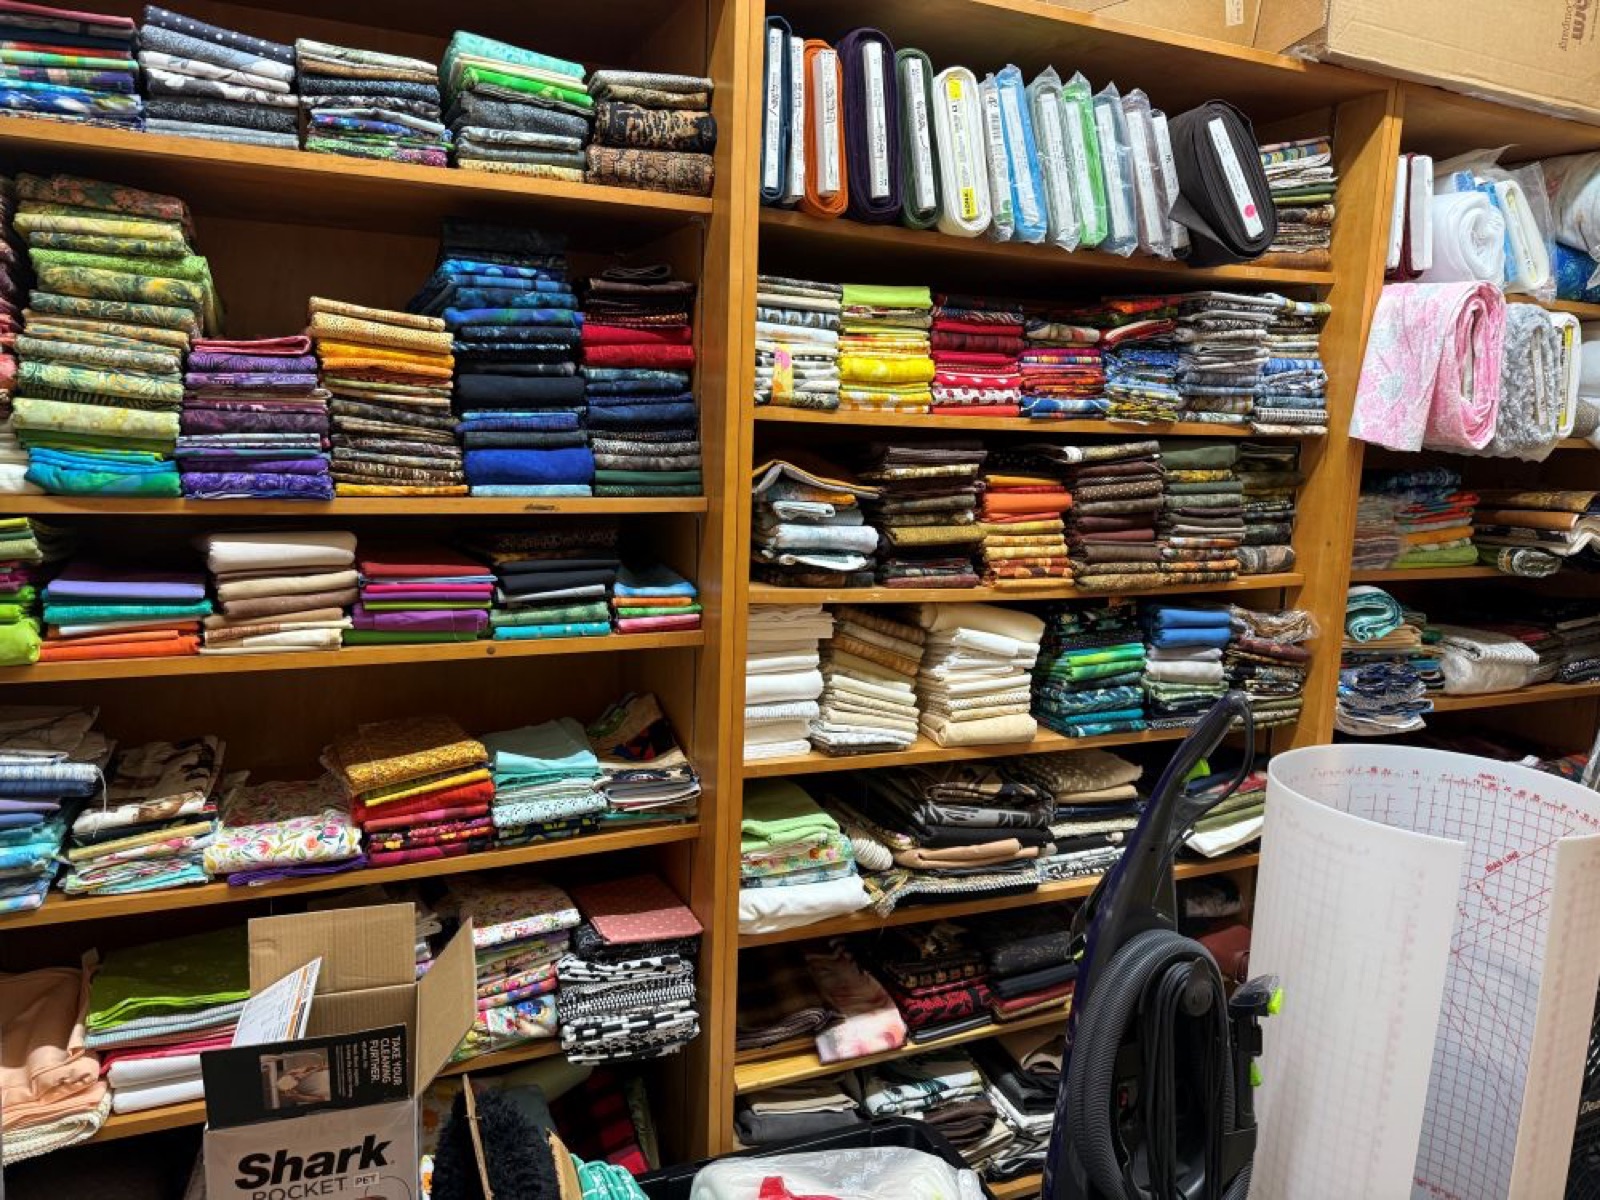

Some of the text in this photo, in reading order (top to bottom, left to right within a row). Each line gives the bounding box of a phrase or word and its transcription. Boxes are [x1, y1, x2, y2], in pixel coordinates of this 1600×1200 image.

[369, 1039, 380, 1084] FURTHER.
[381, 1037, 391, 1083] CLEANING
[391, 1035, 402, 1086] TAKE YOUR
[235, 1133, 392, 1190] Shark
[252, 1174, 377, 1200] ROCKET PET
